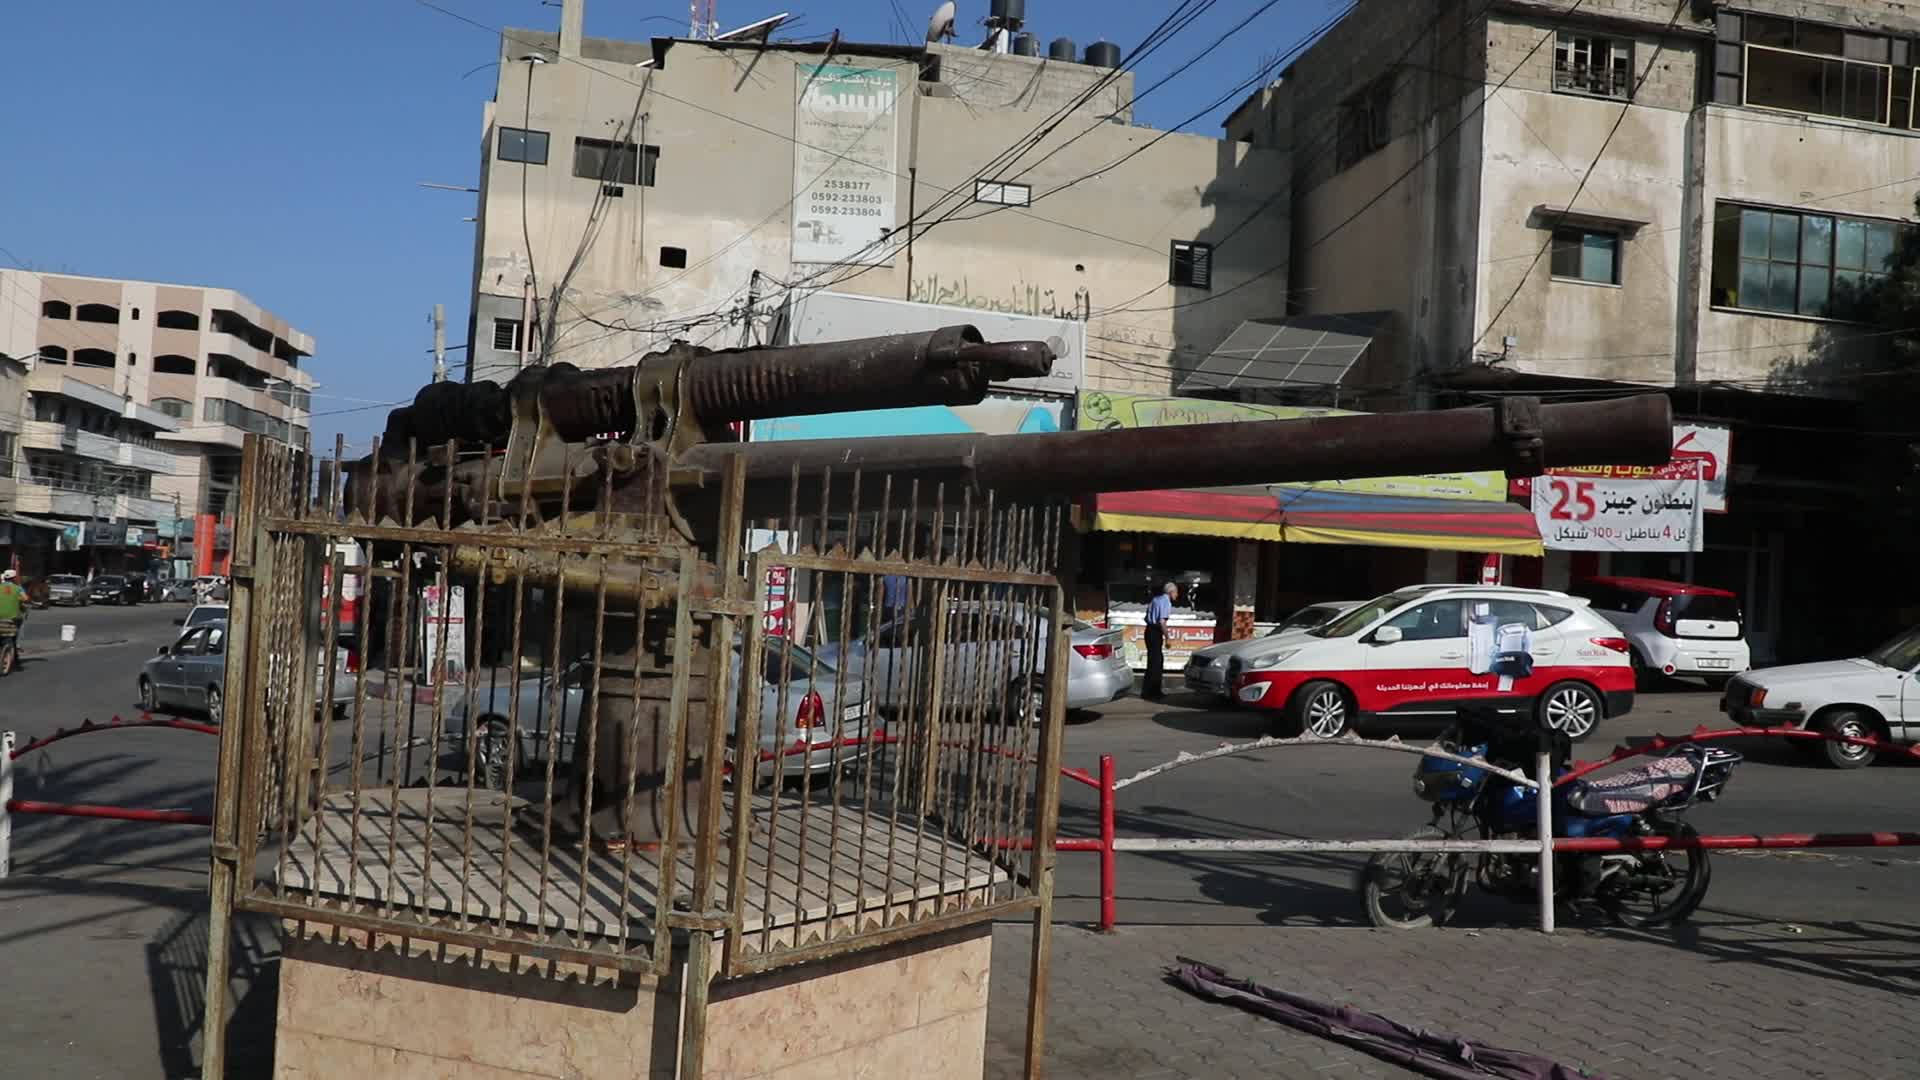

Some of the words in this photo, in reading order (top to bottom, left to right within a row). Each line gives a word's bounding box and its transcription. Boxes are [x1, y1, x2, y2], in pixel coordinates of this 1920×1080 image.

[823, 179, 871, 191] 2538377
[811, 192, 883, 205] 0592-233803
[810, 205, 883, 217] 0592-233804
[1549, 479, 1597, 522] 25
[1600, 490, 1637, 516] جينز
[1641, 491, 1693, 516] بنطلون
[1554, 526, 1590, 542] شيكل
[1592, 527, 1613, 540] 100
[1662, 525, 1671, 539] 4
[1673, 528, 1688, 542] كل
